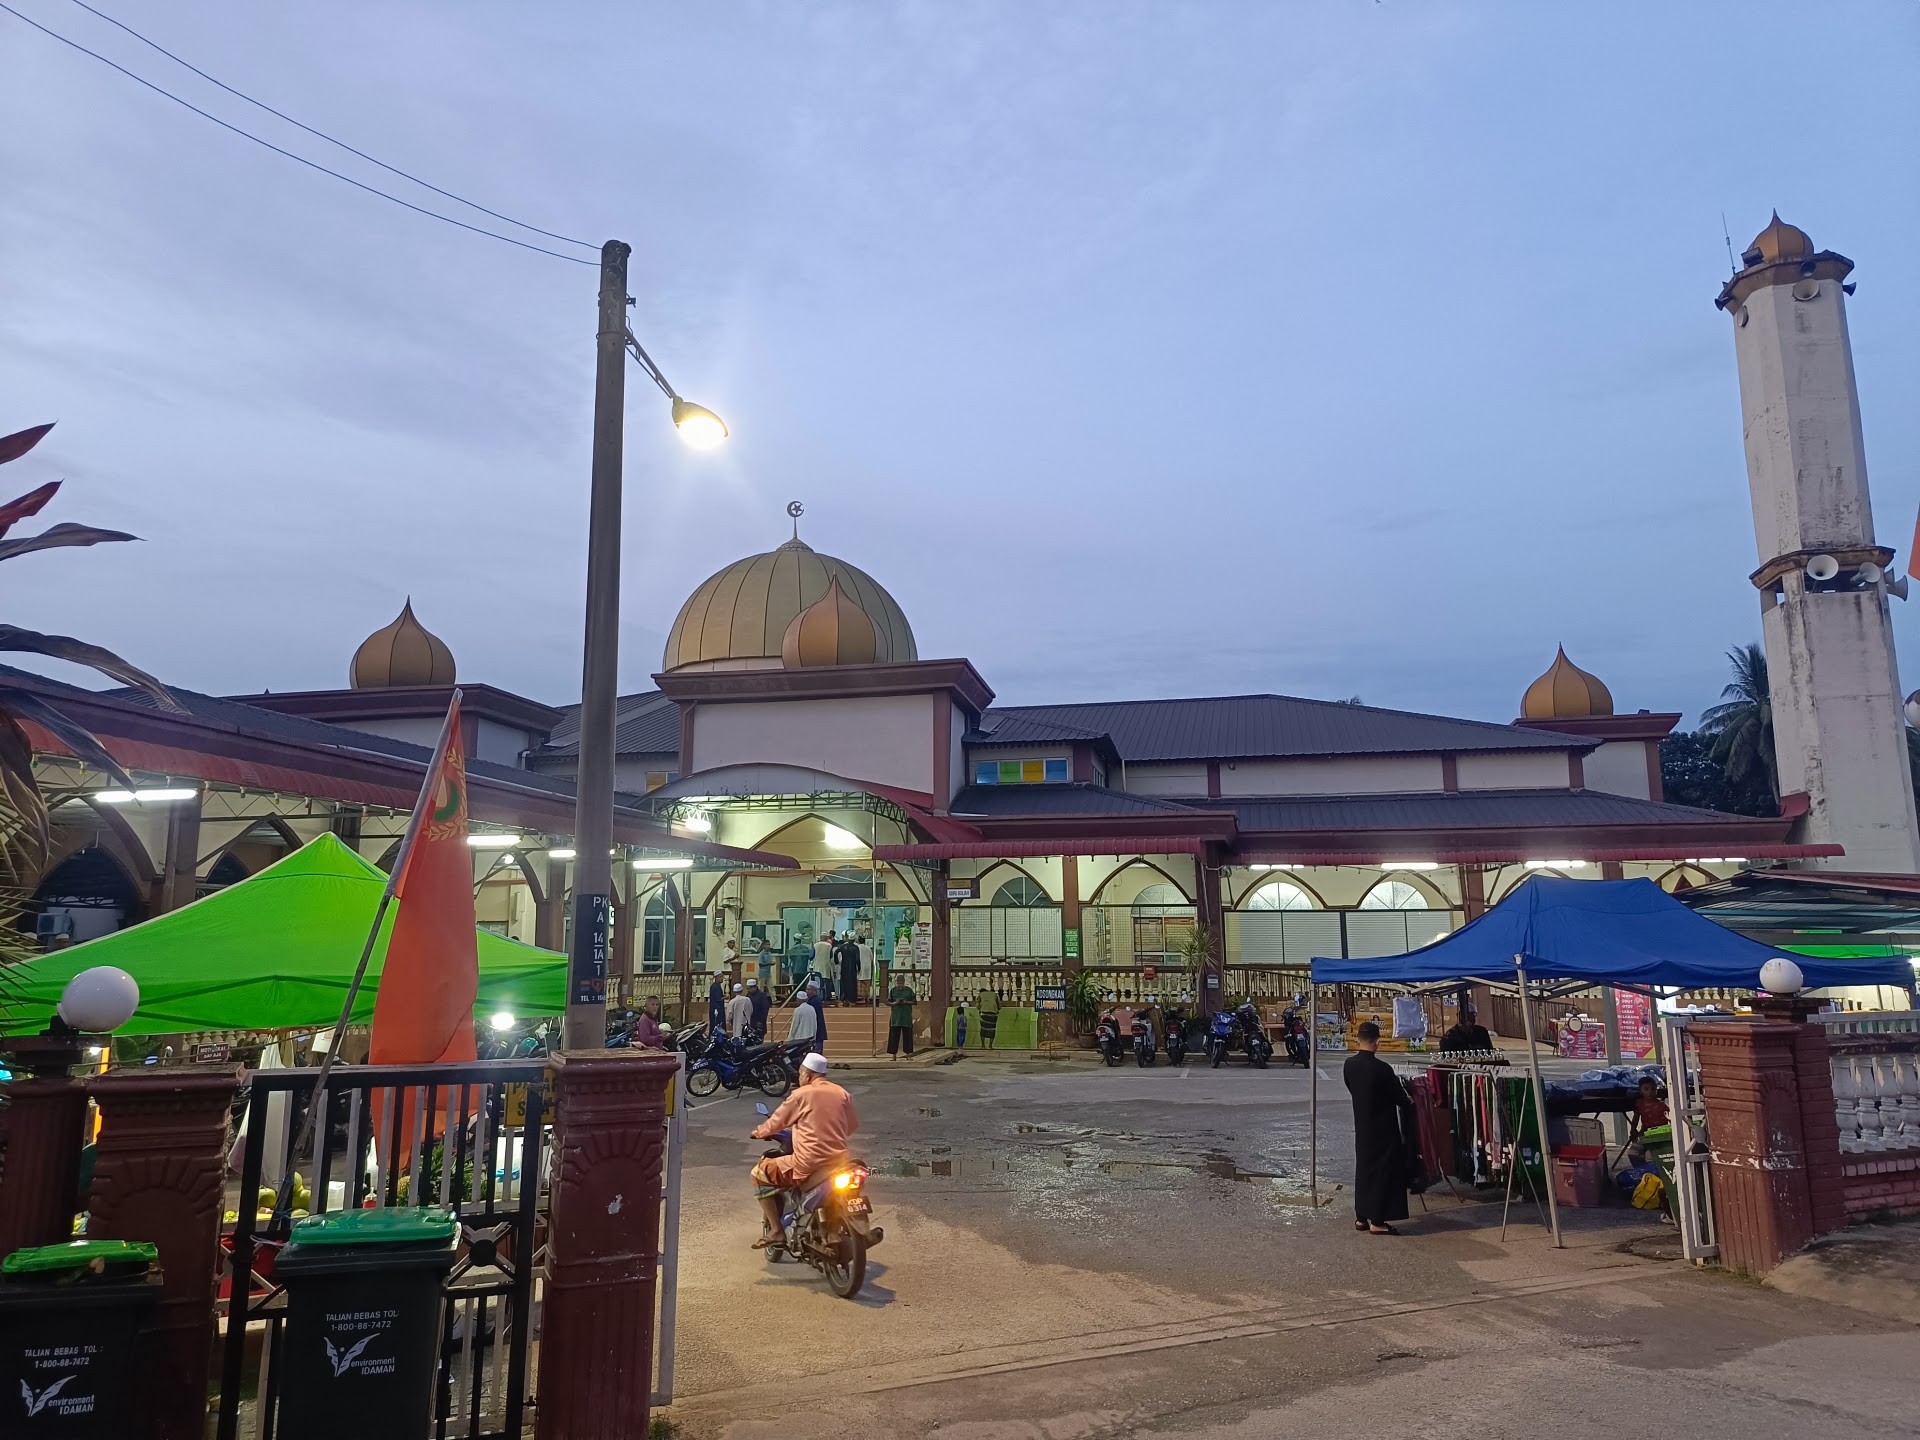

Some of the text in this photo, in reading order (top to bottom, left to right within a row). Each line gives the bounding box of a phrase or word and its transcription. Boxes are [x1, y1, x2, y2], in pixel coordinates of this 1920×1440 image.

[596, 911, 605, 923] A
[325, 1312, 352, 1321] TALIAN
[353, 1310, 381, 1320] BEBAS
[24, 1348, 51, 1357] TALIAN
[53, 1346, 79, 1356] BEBAS
[350, 1356, 395, 1368] environment
[361, 1365, 395, 1375] IDAMAN
[48, 1394, 95, 1407] environment
[59, 1403, 94, 1415] IDAMAN
